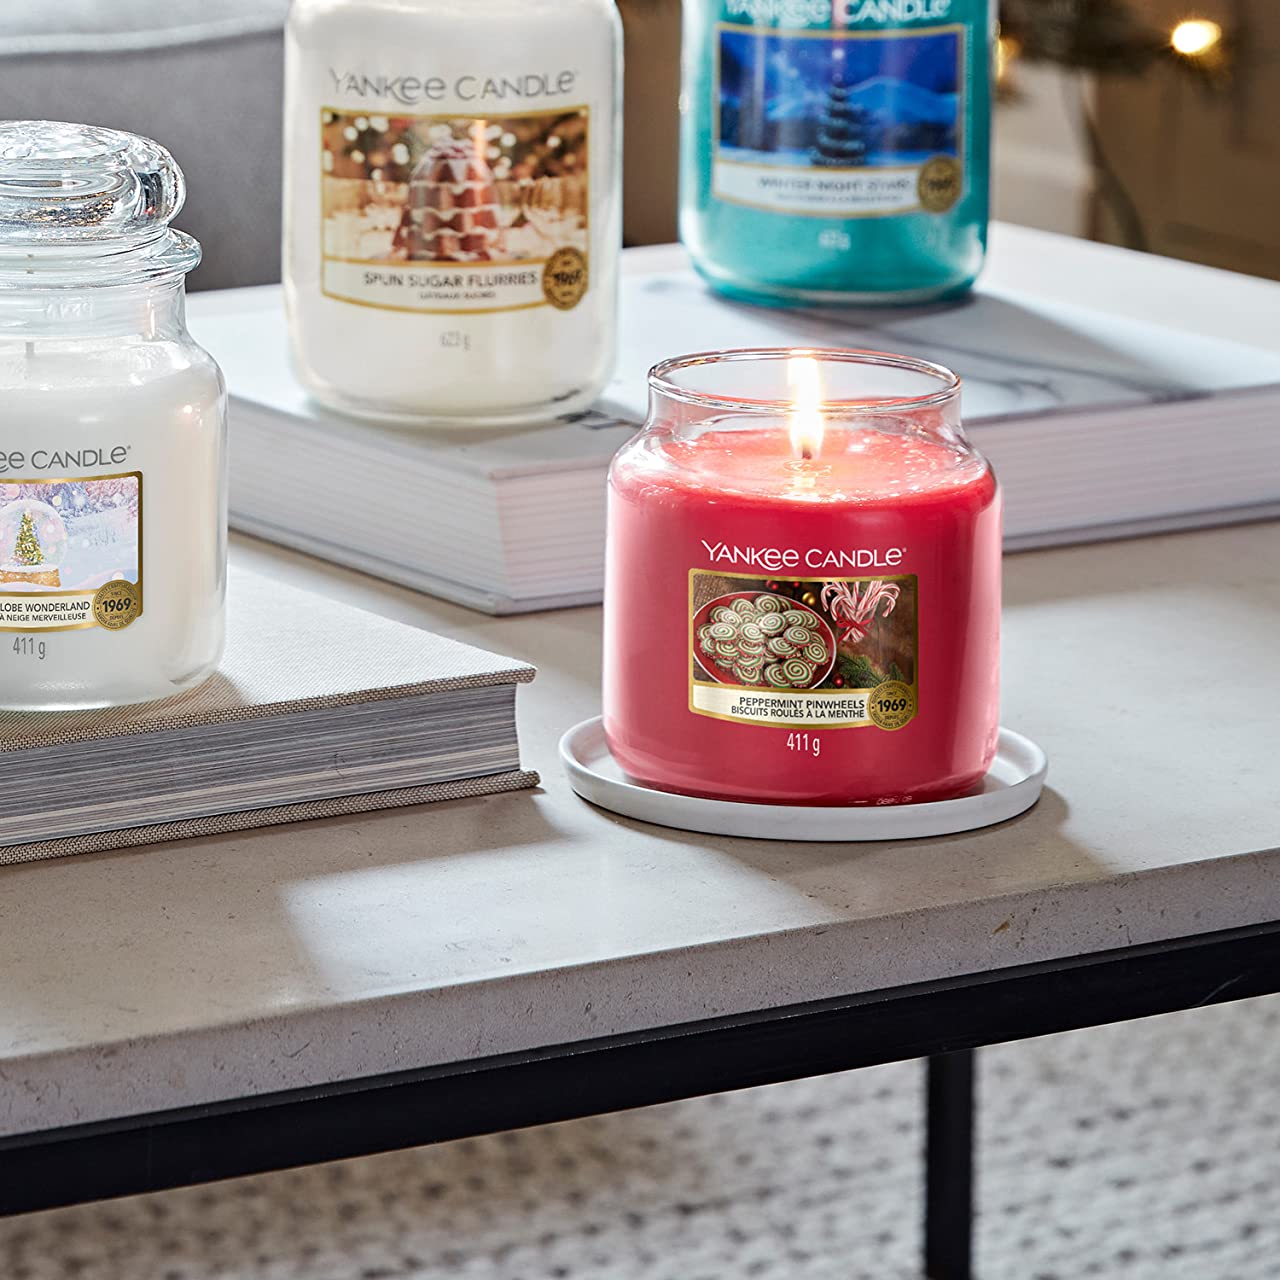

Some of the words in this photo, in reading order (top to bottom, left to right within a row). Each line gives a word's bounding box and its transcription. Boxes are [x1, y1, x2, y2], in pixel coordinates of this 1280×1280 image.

[364, 272, 404, 286] SPUN
[408, 274, 464, 288] SUGAR
[469, 271, 538, 287] FLURRIES
[24, 601, 91, 613] WONDERLAND
[102, 597, 131, 612] 1969
[7, 614, 30, 622] NEIGE
[31, 613, 87, 622] MERVEILLEUSE
[12, 637, 35, 655] 411
[38, 641, 46, 660] g
[739, 696, 804, 710] PEPPERMINT
[806, 699, 865, 710] PINWHEELS
[877, 698, 907, 712] 1969
[731, 706, 769, 717] BISCUITS
[818, 711, 826, 719] LA
[828, 710, 865, 718] MENTHE
[786, 733, 809, 751] 411
[812, 737, 821, 756] g
